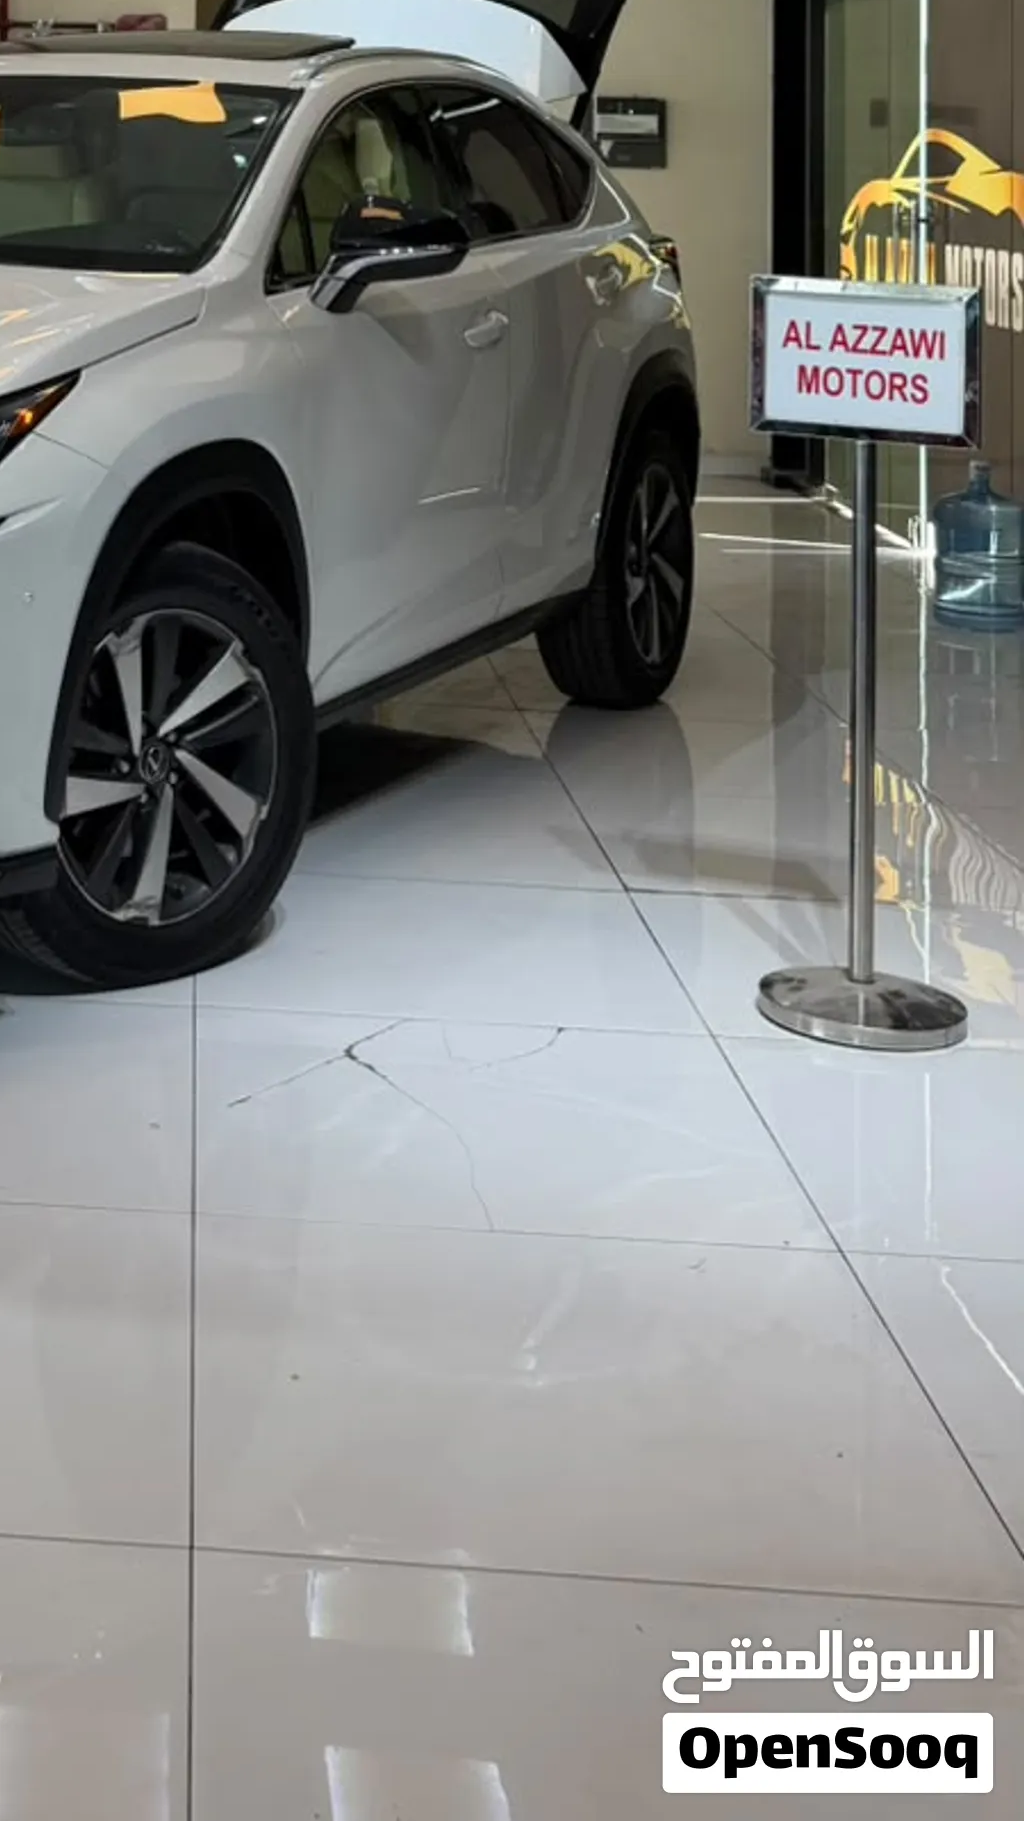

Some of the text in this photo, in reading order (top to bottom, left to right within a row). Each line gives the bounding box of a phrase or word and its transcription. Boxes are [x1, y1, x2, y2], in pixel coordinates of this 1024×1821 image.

[782, 319, 945, 360] AL AZZAWI
[797, 364, 929, 404] MOTORS
